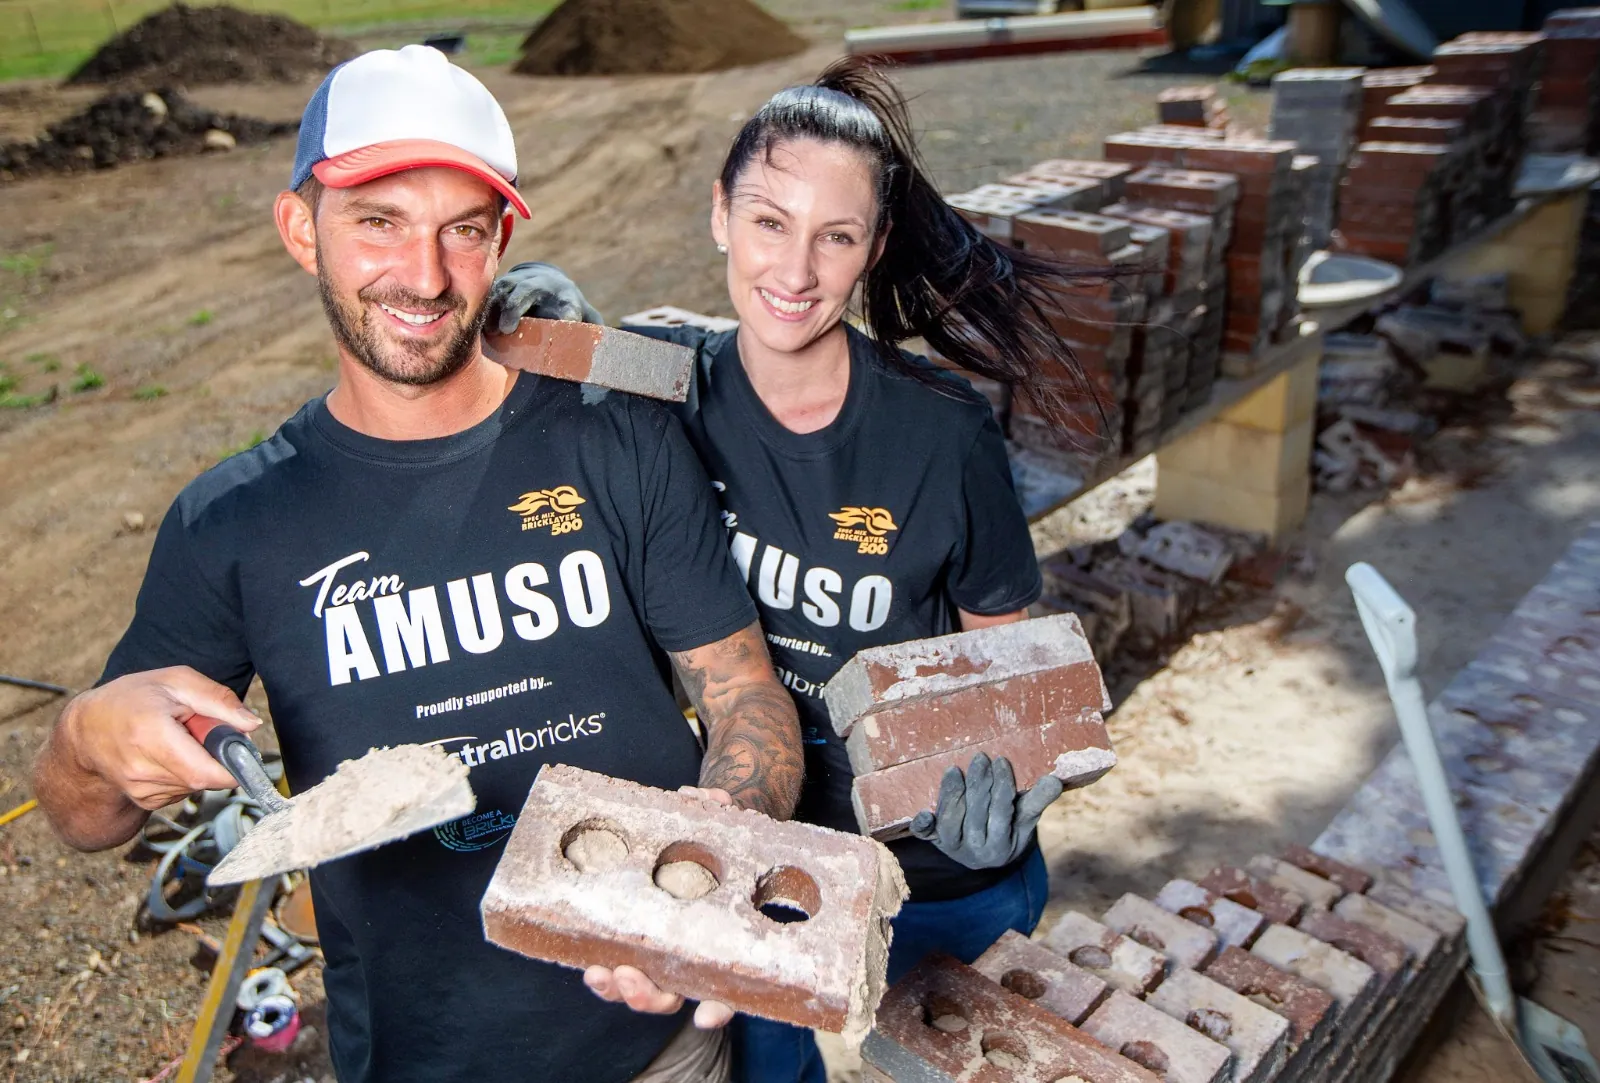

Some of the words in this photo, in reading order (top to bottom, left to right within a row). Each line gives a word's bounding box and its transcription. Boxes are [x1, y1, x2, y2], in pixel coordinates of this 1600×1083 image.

[521, 512, 576, 532] BRICKLAYER
[523, 514, 540, 523] SPEC
[541, 511, 555, 519] MIX
[551, 518, 583, 536] 500
[833, 531, 885, 544] BRICKLAYER
[857, 541, 889, 555] 500
[299, 551, 404, 618] Team
[730, 531, 893, 632] USO
[324, 549, 611, 686] AMUSO
[767, 632, 811, 653] pported
[416, 695, 464, 719] Proudly
[465, 678, 528, 707] supported
[529, 676, 553, 690] by...
[447, 712, 603, 768] tralbricks
[461, 810, 495, 827] BECOME
[495, 809, 502, 817] A
[463, 814, 517, 837] BRICKL
